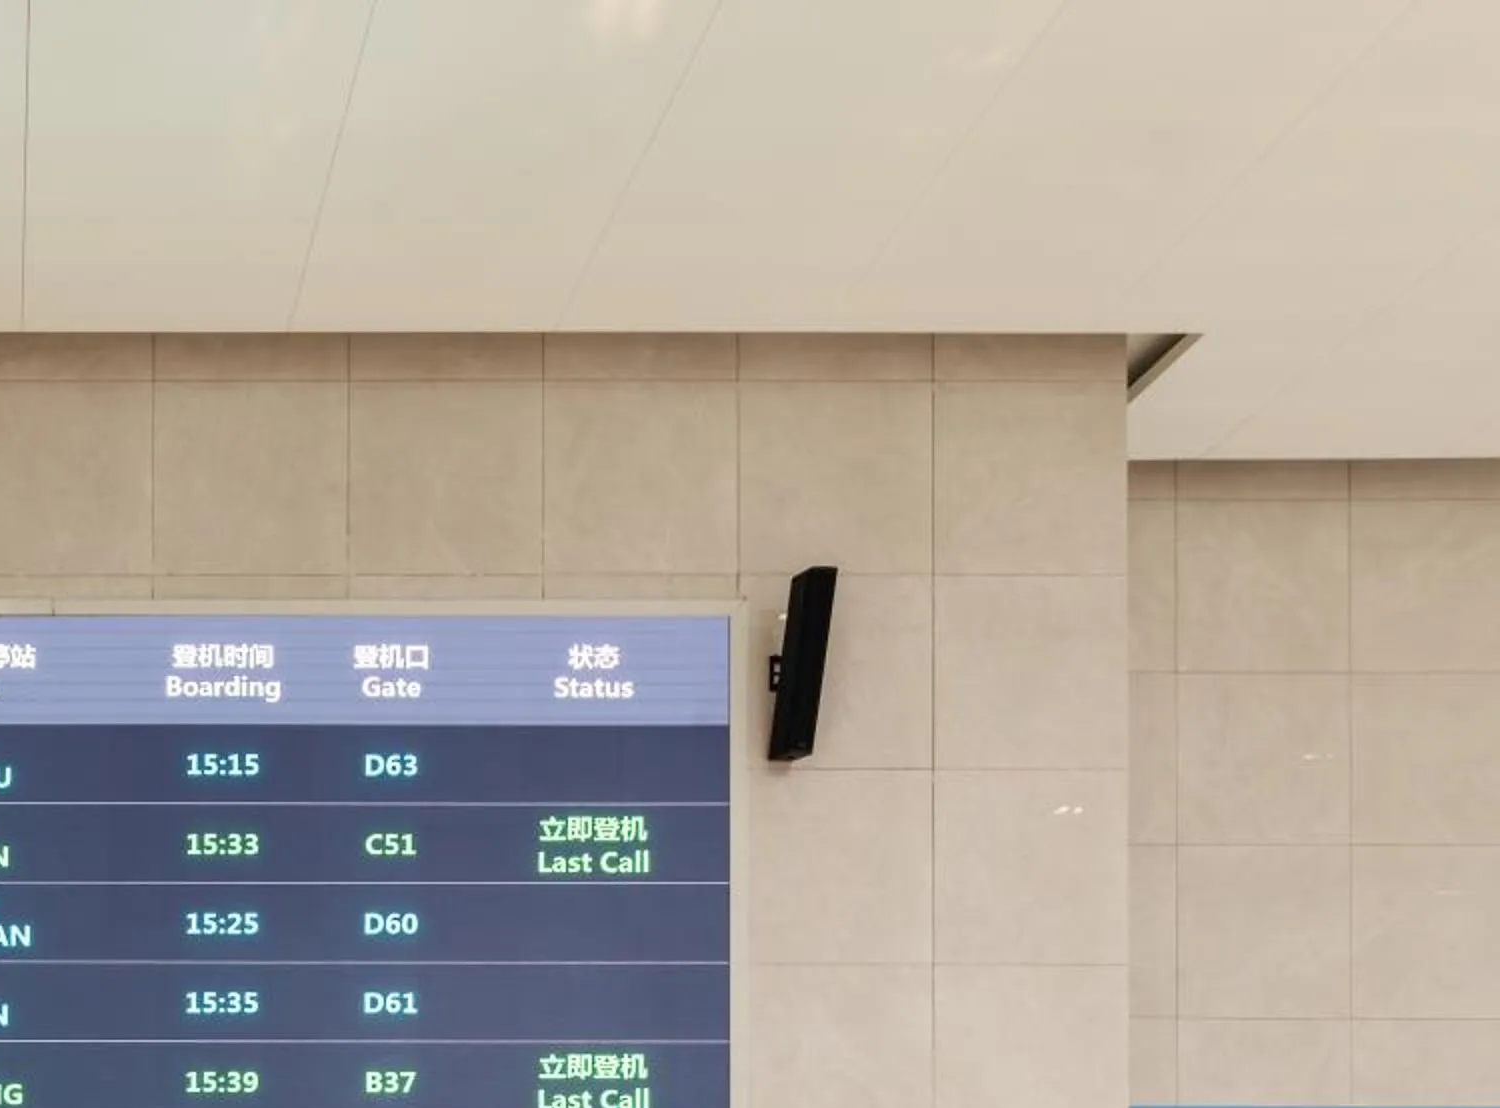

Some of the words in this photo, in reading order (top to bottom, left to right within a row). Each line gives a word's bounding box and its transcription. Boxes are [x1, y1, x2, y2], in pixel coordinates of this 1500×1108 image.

[172, 643, 274, 669] 登机时间
[353, 643, 429, 670] 登机口
[567, 643, 620, 670] 状态
[166, 675, 281, 703] Boarding
[361, 676, 421, 698] Gate
[554, 676, 634, 699] Status
[187, 753, 259, 776] 15:15
[365, 754, 418, 777] D63
[539, 815, 648, 842] 立即登机
[187, 833, 259, 855] 15:33
[365, 833, 417, 855] C51
[538, 851, 593, 873] Last
[599, 849, 649, 874] Call
[186, 912, 259, 935] 15:25
[364, 912, 419, 935] D60
[186, 991, 259, 1014] 15:35
[363, 991, 418, 1014] D61
[538, 1053, 648, 1080] 立即登机
[185, 1071, 259, 1093] 15:39
[365, 1071, 417, 1093] B37
